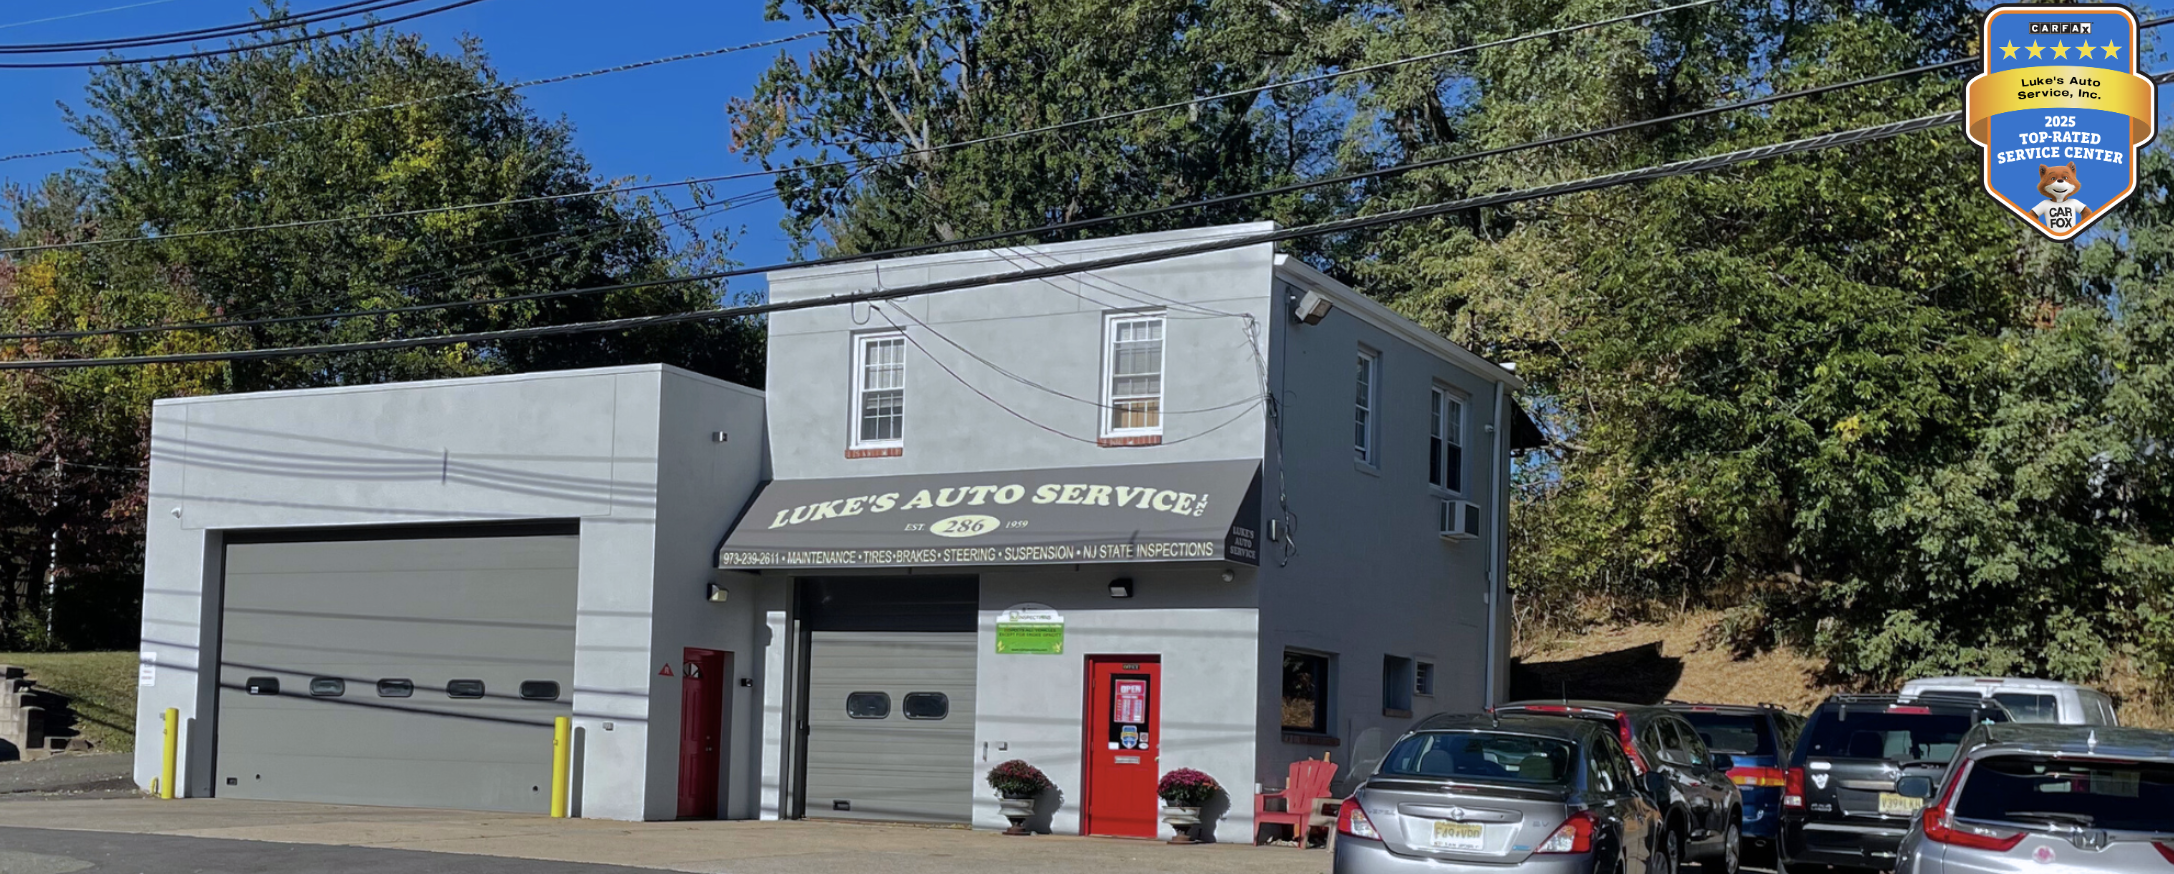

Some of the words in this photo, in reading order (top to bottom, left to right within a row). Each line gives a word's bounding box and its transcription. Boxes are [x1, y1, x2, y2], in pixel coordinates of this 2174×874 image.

[768, 492, 900, 530] LUKE'S
[901, 484, 1025, 510] AUTO
[1031, 484, 1196, 516] SERVICE
[904, 523, 925, 532] EST.
[943, 515, 985, 533] 286
[1005, 519, 1029, 529] 1959
[1234, 536, 1253, 548] AUTO
[723, 552, 779, 565] 973-239-2611
[787, 550, 856, 564] MAINTENANCE
[943, 547, 996, 563] STEERING
[1004, 545, 1074, 561] SUSPENSION
[1083, 545, 1097, 560] NJ
[1099, 543, 1134, 559] STATE
[1136, 542, 1214, 558] INSPECTIONS
[1230, 545, 1256, 559] SERVICE
[1120, 685, 1142, 694] OPEN
